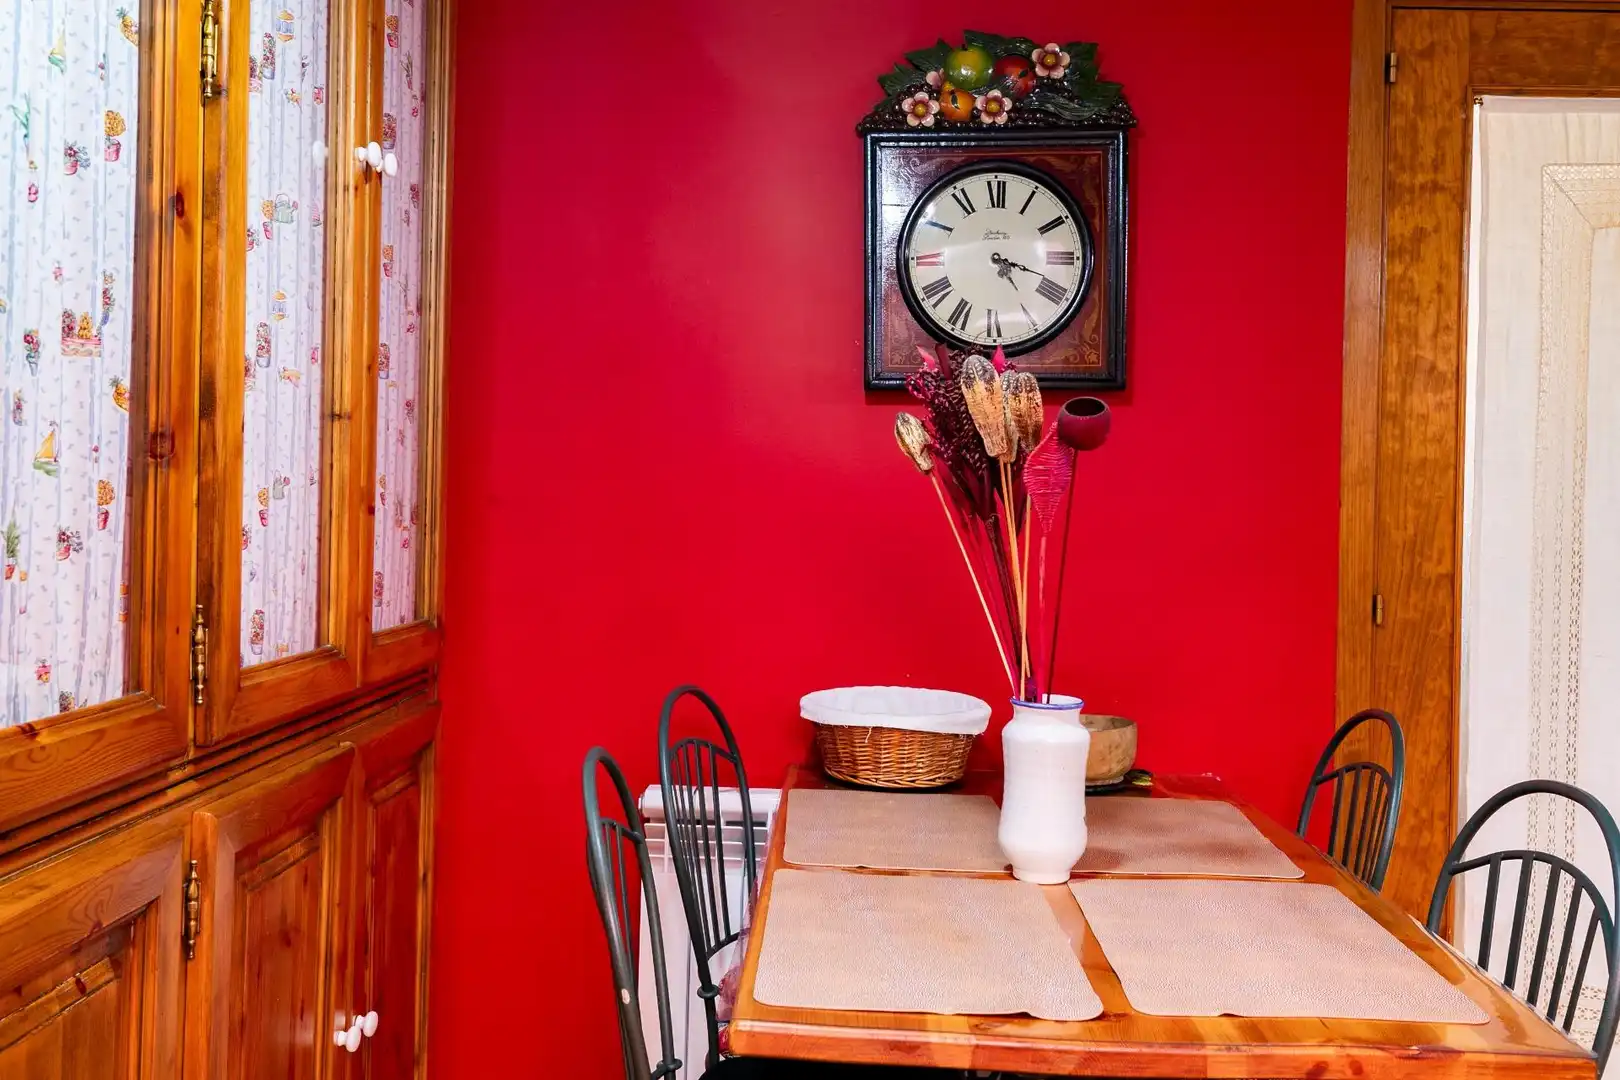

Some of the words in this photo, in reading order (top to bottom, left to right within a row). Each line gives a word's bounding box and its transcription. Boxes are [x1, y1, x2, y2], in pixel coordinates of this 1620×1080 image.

[951, 187, 977, 219] XI
[985, 180, 1007, 210] XII
[1018, 187, 1038, 216] I
[1037, 214, 1068, 236] II
[1045, 250, 1075, 266] III
[921, 273, 956, 309] VIII
[947, 296, 973, 332] VII
[984, 308, 1003, 338] VI
